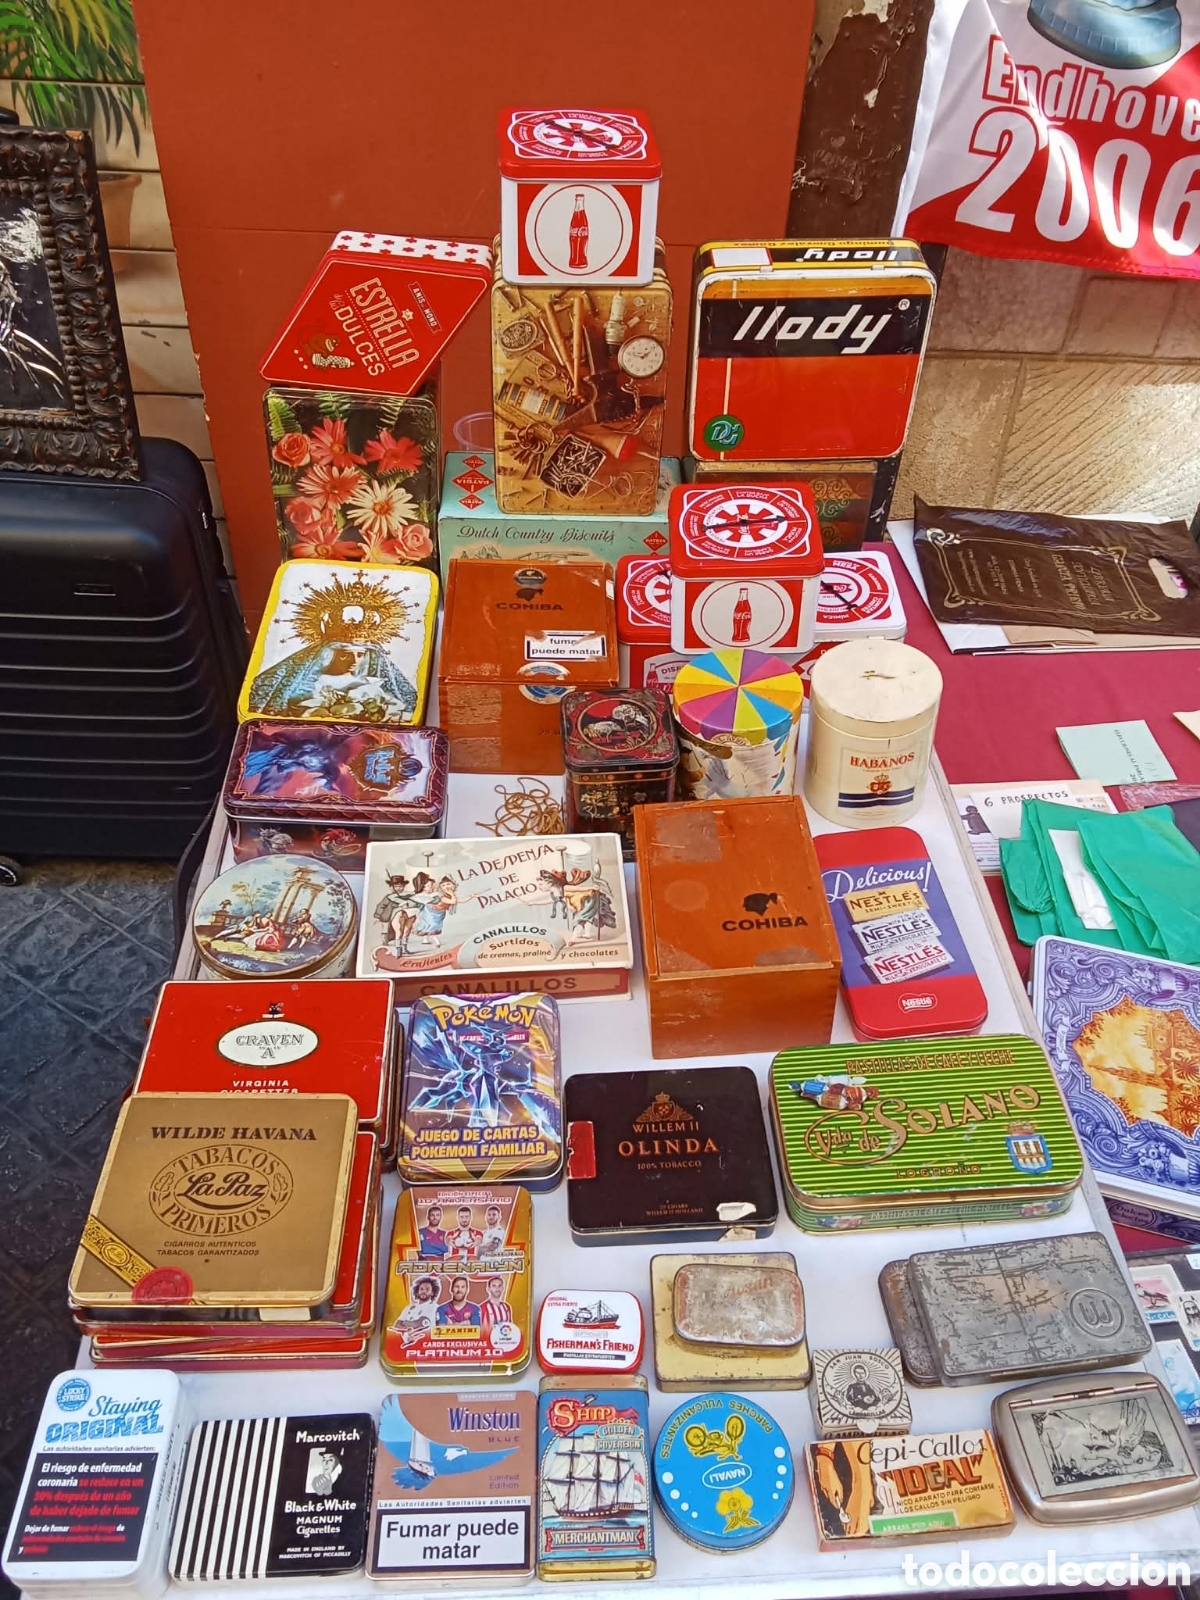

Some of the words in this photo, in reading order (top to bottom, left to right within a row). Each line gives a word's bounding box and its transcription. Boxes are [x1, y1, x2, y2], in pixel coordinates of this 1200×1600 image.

[954, 105, 1200, 258] 2006
[411, 287, 426, 304] ANIS
[424, 307, 438, 327] MONO
[349, 277, 421, 369] ESTRELLA
[334, 305, 386, 376] DULCES
[456, 525, 500, 540] Dutch
[505, 526, 555, 544] Country
[559, 528, 616, 544] Biscuits
[495, 602, 564, 611] COHIBA
[531, 647, 566, 656] puede
[568, 647, 601, 656] matar
[849, 751, 916, 769] HABANOS
[984, 796, 994, 808] 6
[478, 843, 555, 873] DESPENSA
[500, 872, 520, 888] DE
[821, 861, 931, 903] Delicious!
[477, 882, 538, 909] PALACIO
[721, 916, 809, 933] COHIBA
[473, 926, 547, 945] CANALILLOS
[489, 938, 541, 951] Surtidos
[489, 951, 521, 960] cremas,
[568, 948, 619, 957] chocolates
[420, 977, 578, 996] CANALILLOS
[236, 1034, 305, 1047] CRAVEN
[260, 1048, 276, 1059] A
[846, 1056, 915, 1075] PASTILLAS
[915, 1055, 933, 1069] DE
[975, 1049, 1014, 1066] LECHE
[858, 1126, 882, 1152] de
[873, 1084, 1042, 1152] SOLANO
[151, 1127, 225, 1141] WILDE
[230, 1127, 317, 1141] HAVANA
[416, 1131, 459, 1144] JUEGO
[462, 1131, 480, 1141] DE
[483, 1126, 538, 1141] CARTAS
[632, 1122, 686, 1134] WILLEM
[689, 1121, 700, 1132] II
[481, 1141, 546, 1157] FAMILIAR
[617, 1137, 721, 1157] OLINDA
[172, 1146, 280, 1176] TABACOS
[637, 1162, 657, 1170] 100%
[660, 1160, 702, 1169] TOBACCO
[895, 1160, 981, 1179] LOGROÑO
[435, 1196, 513, 1206] ANIVERSARIO
[159, 1203, 271, 1236] PRIMEROS
[197, 1249, 260, 1257] GARANTIZADOS
[396, 1260, 525, 1275] ADRENALYN
[446, 1340, 488, 1348] EXCLUSIVAS
[546, 1338, 602, 1350] FISHERMAN'S
[602, 1339, 635, 1352] FRIEND
[405, 1349, 480, 1358] PLATINUM
[482, 1349, 503, 1357] 10
[829, 1359, 841, 1370] SAN
[869, 1356, 890, 1370] BOSCO
[60, 1394, 86, 1402] STRIKE
[64, 1387, 86, 1396] LUCKY
[88, 1395, 163, 1418] Staying
[553, 1401, 615, 1428] SHIP
[447, 1406, 521, 1432] Winston
[729, 1400, 774, 1434] PARCHES
[45, 1413, 164, 1443] ORIGINAL
[602, 1425, 635, 1436] GOLDEN
[660, 1399, 723, 1459] VULCANIZANTES
[296, 1429, 360, 1444] Marcovitch
[597, 1441, 641, 1450] SOVEREIGN
[857, 1434, 988, 1469] Cepi-Callos
[41, 1463, 50, 1473] El
[50, 1463, 78, 1475] riesgo
[78, 1463, 89, 1472] de
[89, 1462, 142, 1473] enfermedad
[709, 1467, 746, 1483] NAVALI
[37, 1476, 78, 1487] coronaria
[489, 1481, 519, 1489] Edition
[89, 1491, 101, 1501] de
[914, 1492, 946, 1504] APARATO
[946, 1489, 964, 1499] PARA
[964, 1483, 996, 1495] CORTARSE
[30, 1505, 39, 1516] de
[99, 1505, 111, 1516] de
[112, 1505, 139, 1516] fumar
[900, 1505, 914, 1514] LOS
[914, 1502, 940, 1512] CALLOS
[941, 1499, 952, 1507] SIN
[952, 1494, 981, 1505] PELIGRO
[296, 1515, 343, 1525] MAGNUM
[24, 1524, 41, 1534] Dejar
[41, 1524, 50, 1532] de
[50, 1524, 70, 1533] fumar
[116, 1524, 125, 1532] de
[296, 1525, 341, 1538] Cigarettes
[387, 1521, 451, 1538] Fumar
[456, 1518, 519, 1541] puede
[555, 1531, 636, 1544] MERCHANTMAN
[422, 1542, 480, 1559] matar
